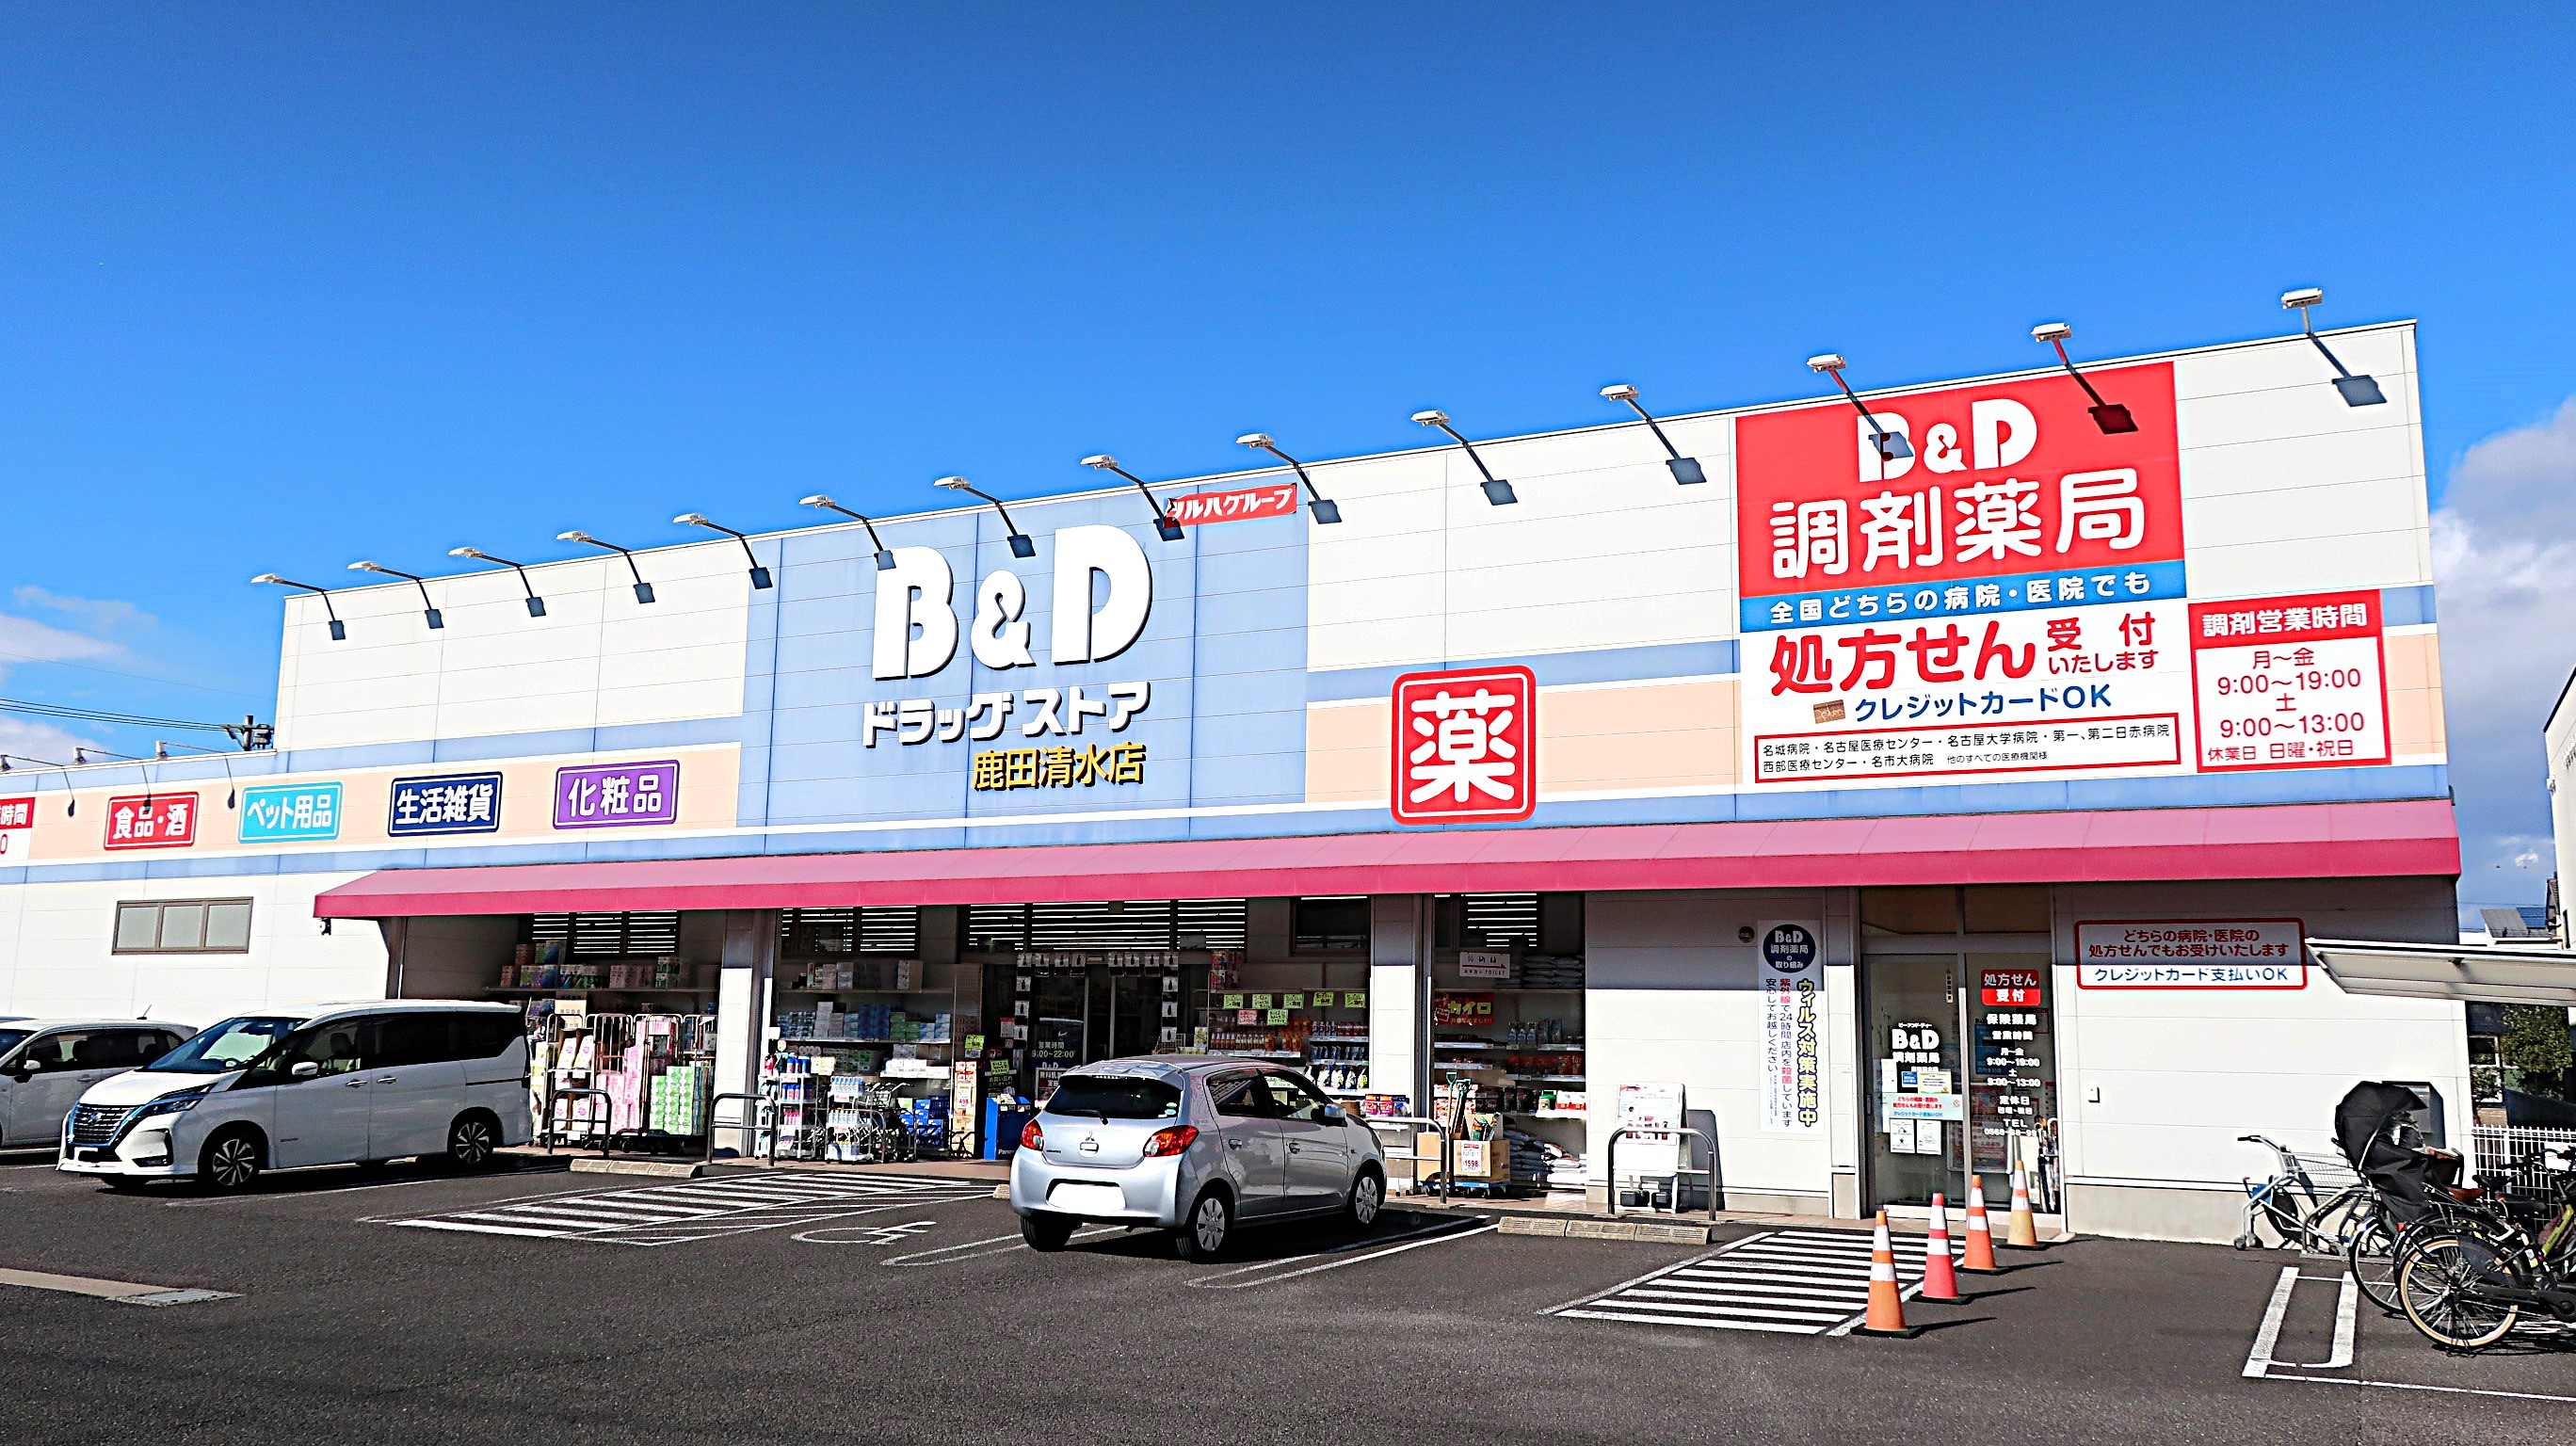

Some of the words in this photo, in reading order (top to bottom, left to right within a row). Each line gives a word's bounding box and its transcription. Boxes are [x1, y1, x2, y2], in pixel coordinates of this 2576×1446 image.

[1857, 398, 2037, 483] B&D
[1770, 468, 2146, 579] 調剤薬局
[871, 524, 1152, 681] B&D
[1770, 570, 2150, 624] 全国どちらの病院・医院でも
[2202, 603, 2367, 636] 調剤営業時間
[1769, 620, 2036, 697] 処方せん
[2049, 649, 2159, 674] いたします
[1855, 684, 2112, 722] クレジットカードOK
[2276, 693, 2296, 712] 土
[1410, 688, 1516, 803] 薬
[2208, 746, 2256, 762] 休業日
[2270, 740, 2353, 759] 日曜・祝日
[971, 742, 1147, 792] 鹿田清水店
[395, 783, 492, 825] 生活雑貨
[568, 774, 662, 816] 化粧品
[0, 803, 29, 827] 時間
[112, 803, 188, 840] 食品・酒
[248, 794, 332, 830] ペット用品
[1775, 930, 1803, 943] B&D
[2123, 929, 2260, 943] どちらの病院・医院の
[1770, 944, 1809, 955] 調剤薬局
[2088, 943, 2289, 958] 処方せんでもお受けいたします
[1984, 973, 2037, 987] 処方せん
[2094, 967, 2289, 982] クレジットカード支払いOK
[1448, 1000, 1491, 1016] カイロ
[1995, 988, 2025, 1003] 受付
[1892, 1028, 1940, 1050] B&D
[2003, 1118, 2028, 1128] TEL
